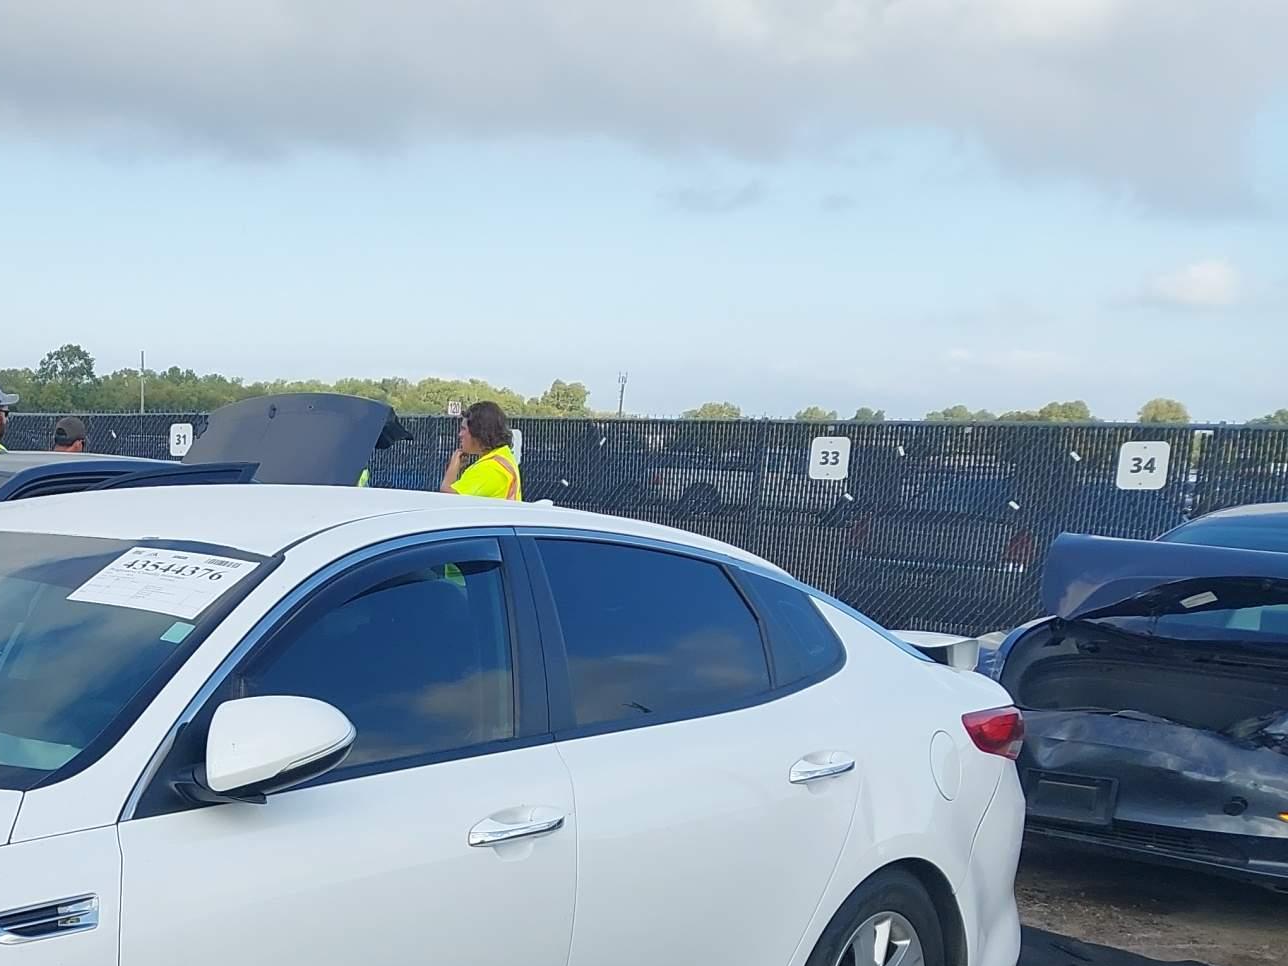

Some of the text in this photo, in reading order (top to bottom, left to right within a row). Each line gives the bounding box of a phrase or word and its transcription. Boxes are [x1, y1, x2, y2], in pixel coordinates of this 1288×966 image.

[175, 434, 187, 445] 31
[819, 450, 840, 466] 33
[1129, 457, 1157, 474] 34
[123, 559, 229, 581] 43544376
